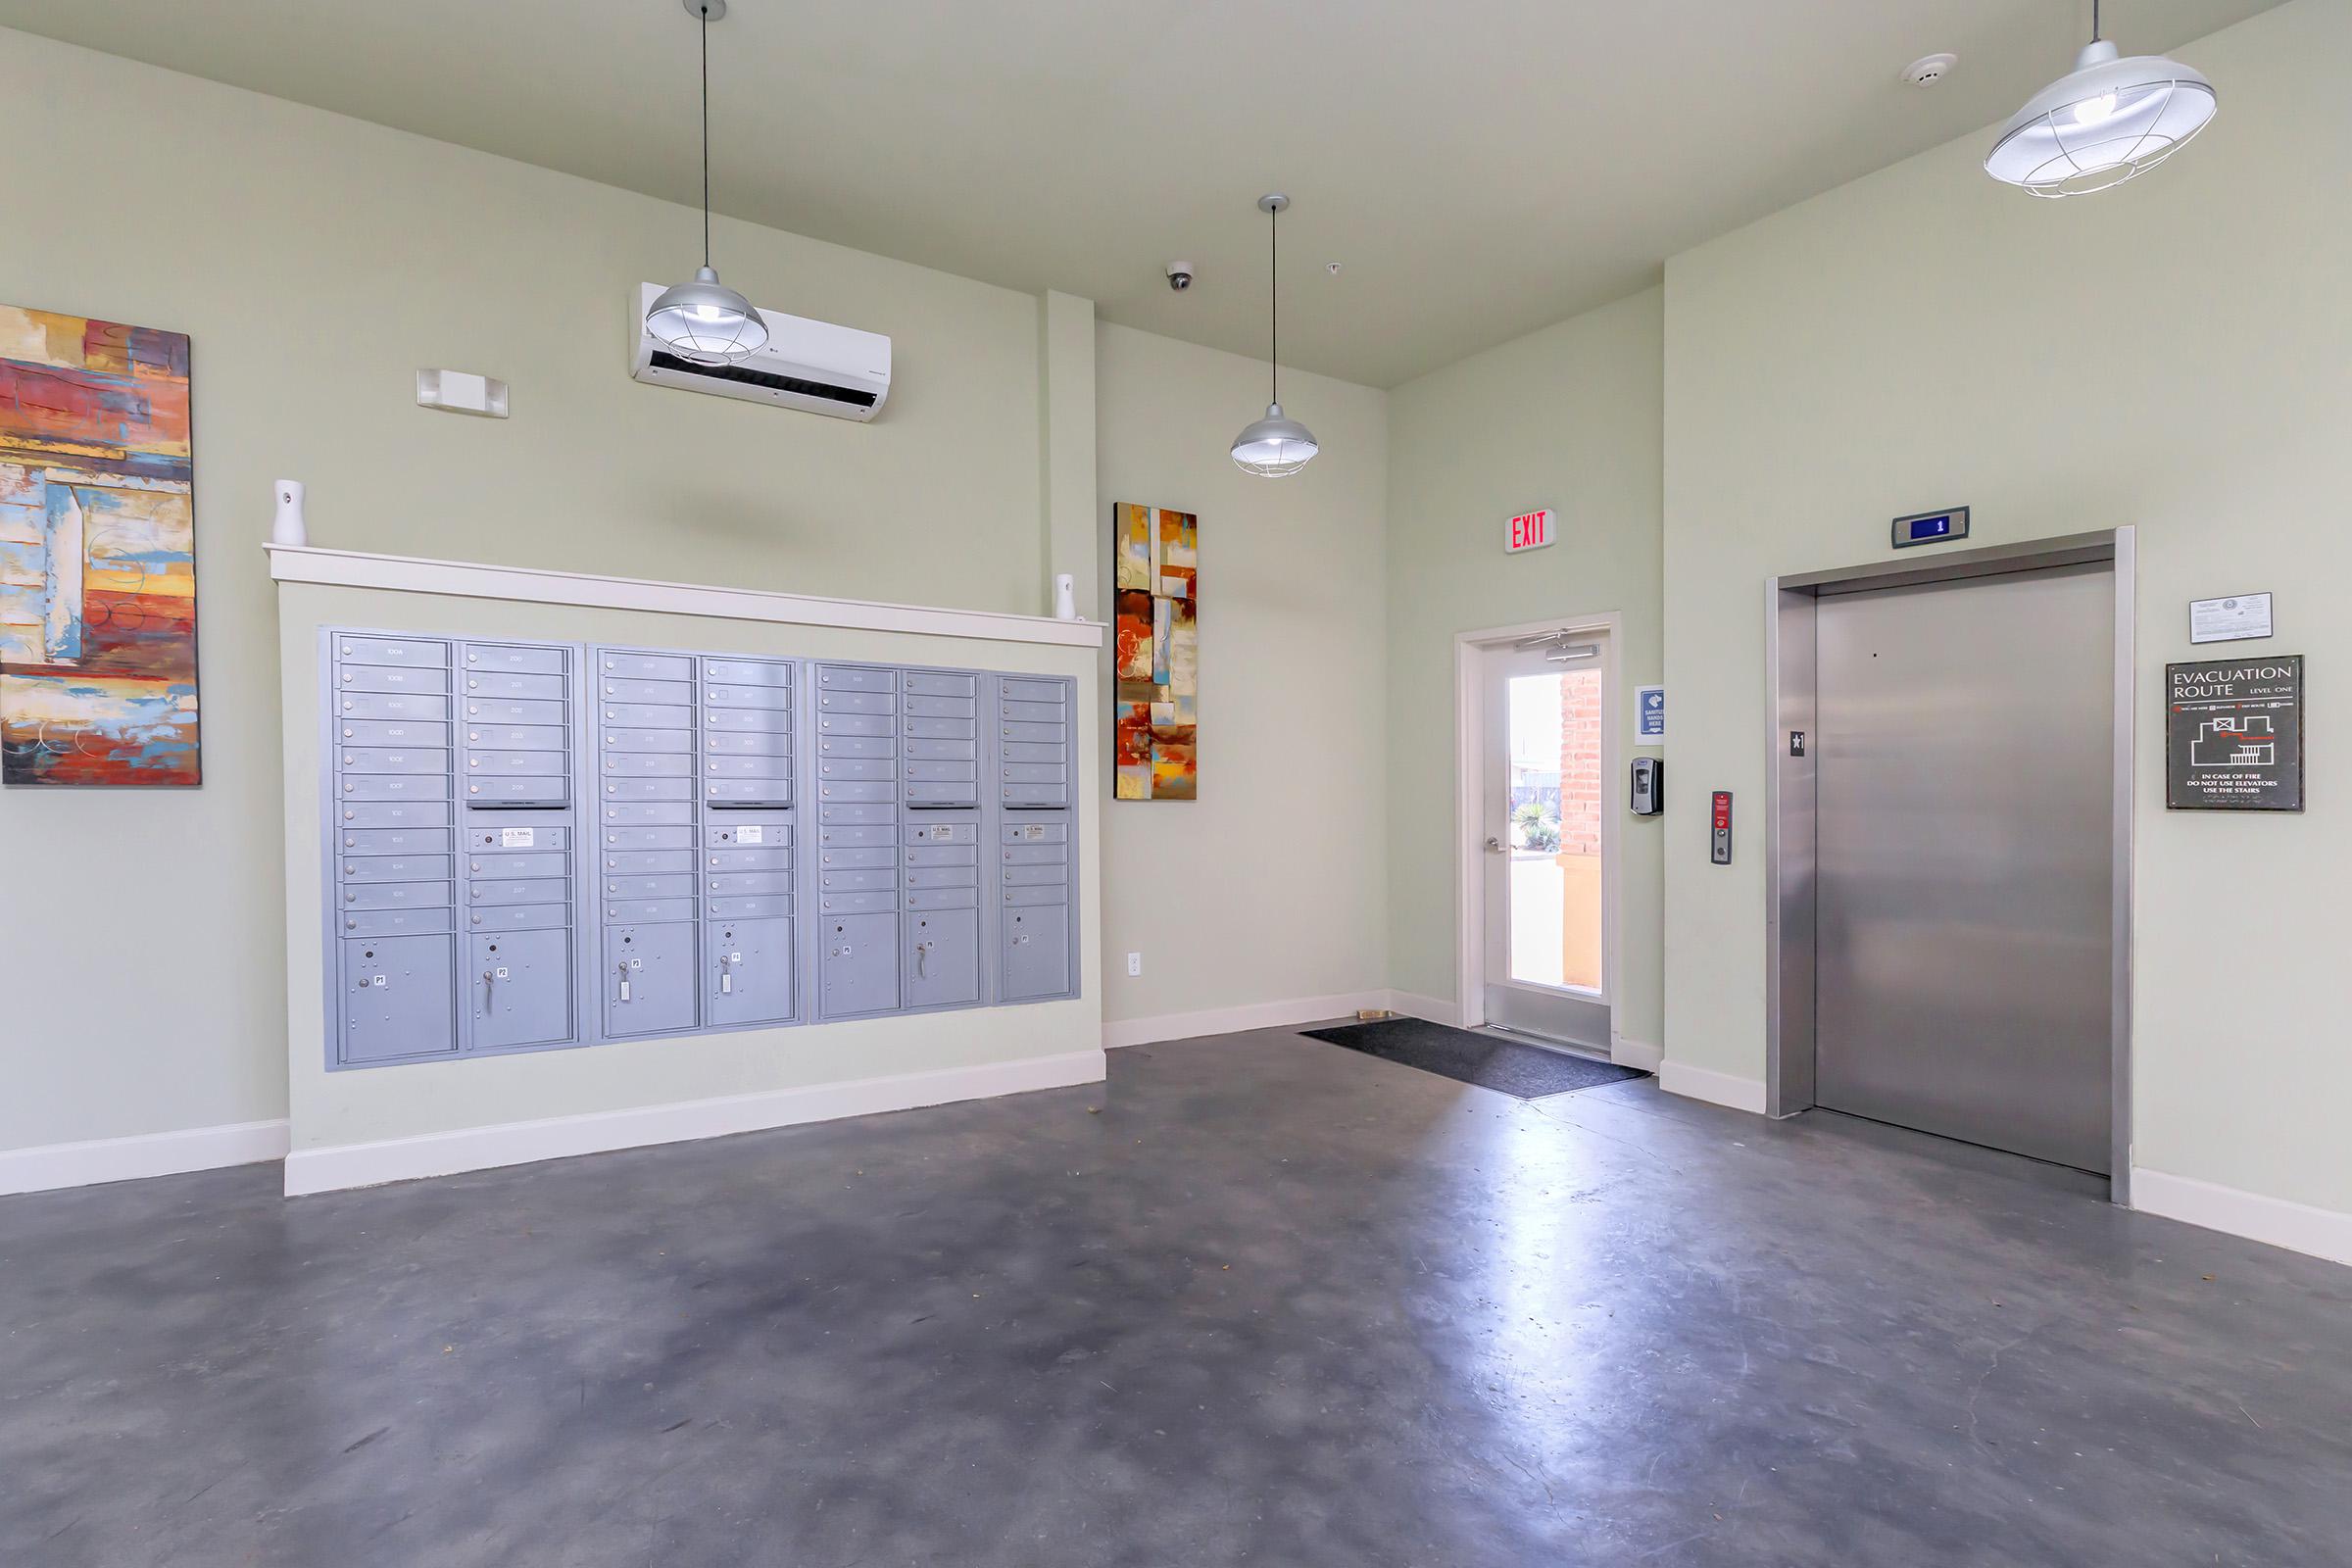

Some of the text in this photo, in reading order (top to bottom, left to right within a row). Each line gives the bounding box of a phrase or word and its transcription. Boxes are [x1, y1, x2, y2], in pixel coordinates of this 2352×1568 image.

[1512, 511, 1546, 549] EXIT
[1936, 520, 1944, 532] 1
[2174, 666, 2292, 684] EVACUATION
[2174, 684, 2233, 698] ROUTE
